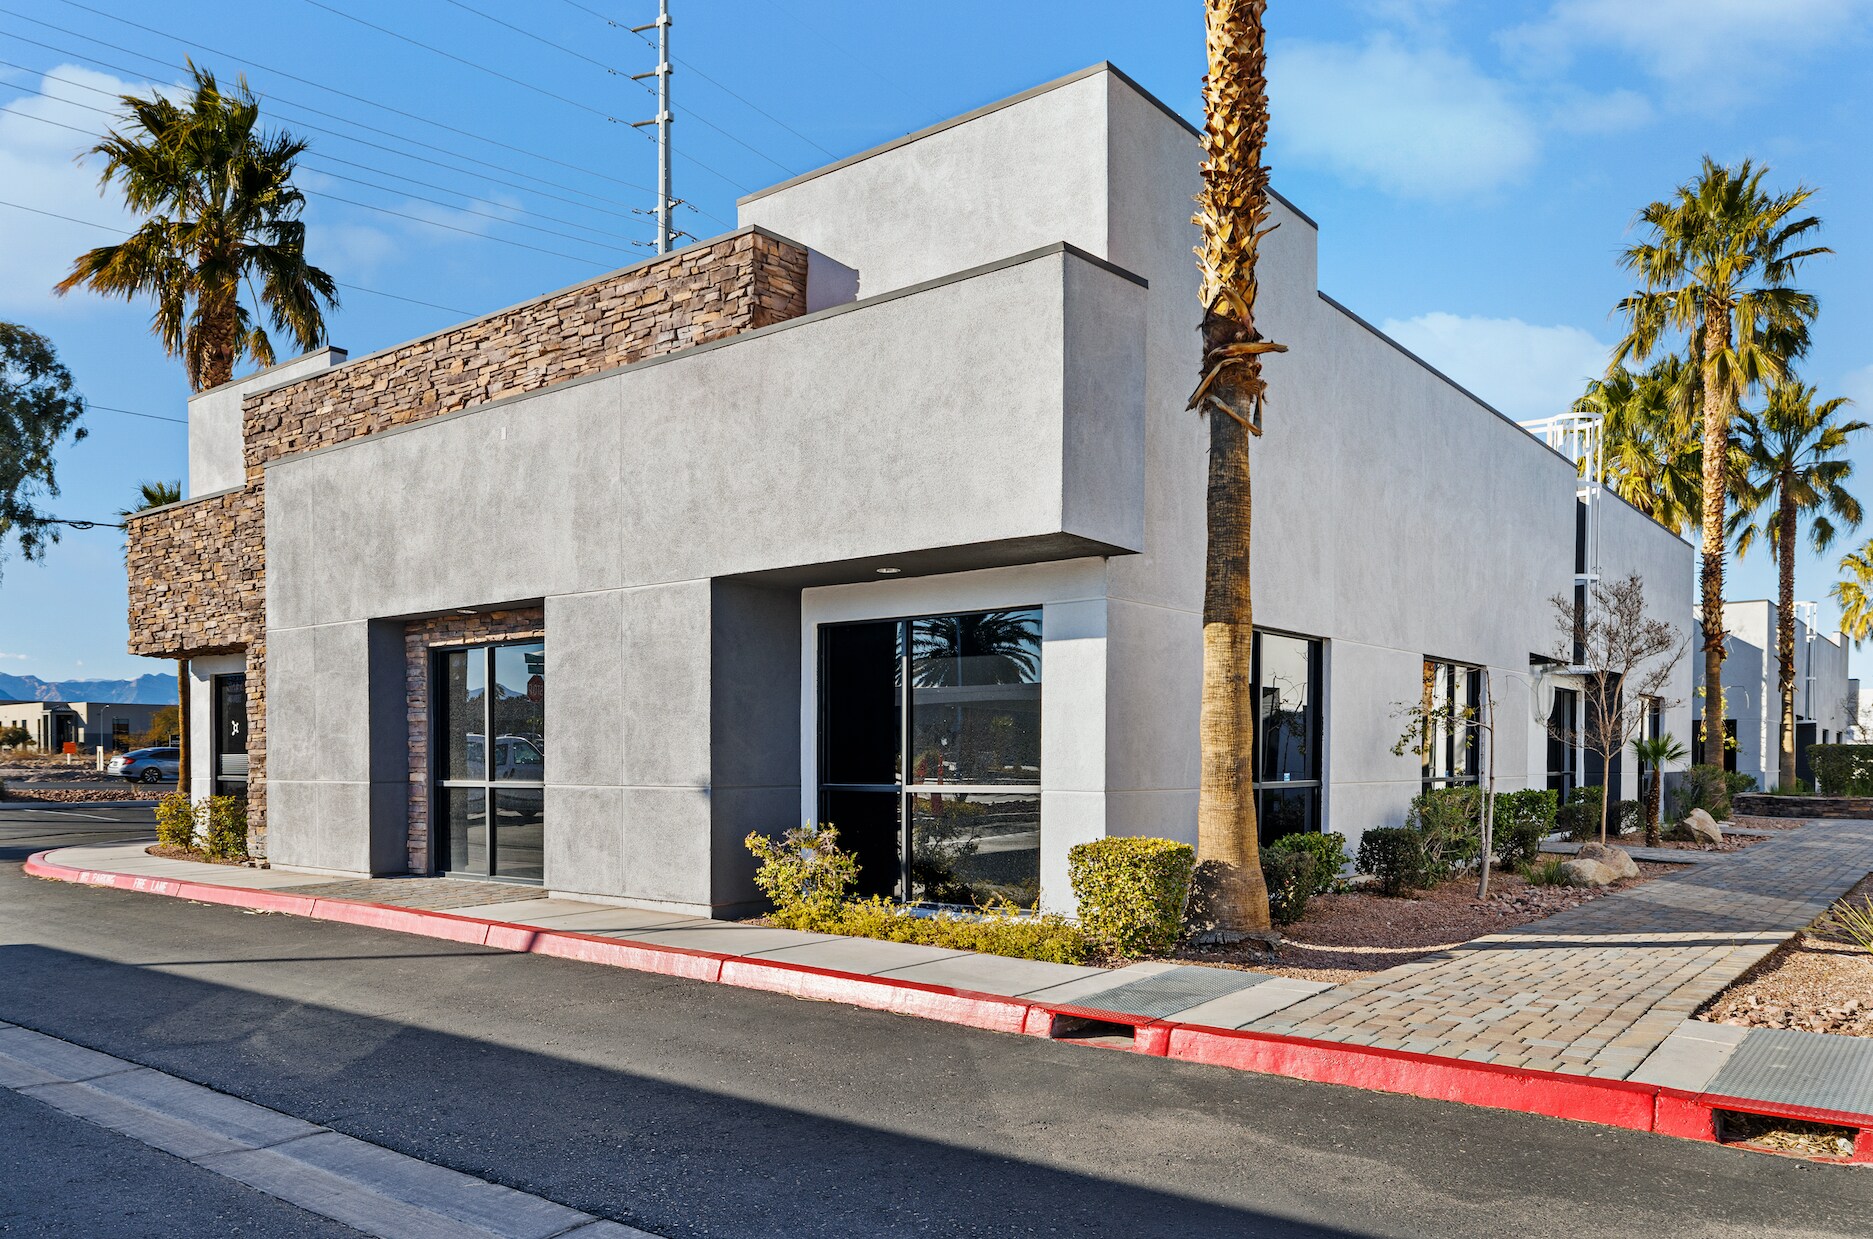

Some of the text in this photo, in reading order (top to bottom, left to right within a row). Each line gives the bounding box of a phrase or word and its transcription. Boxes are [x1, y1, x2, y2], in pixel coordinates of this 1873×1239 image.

[92, 873, 116, 884] PARKING
[133, 877, 147, 889] FIRE
[150, 880, 168, 892] LANE
